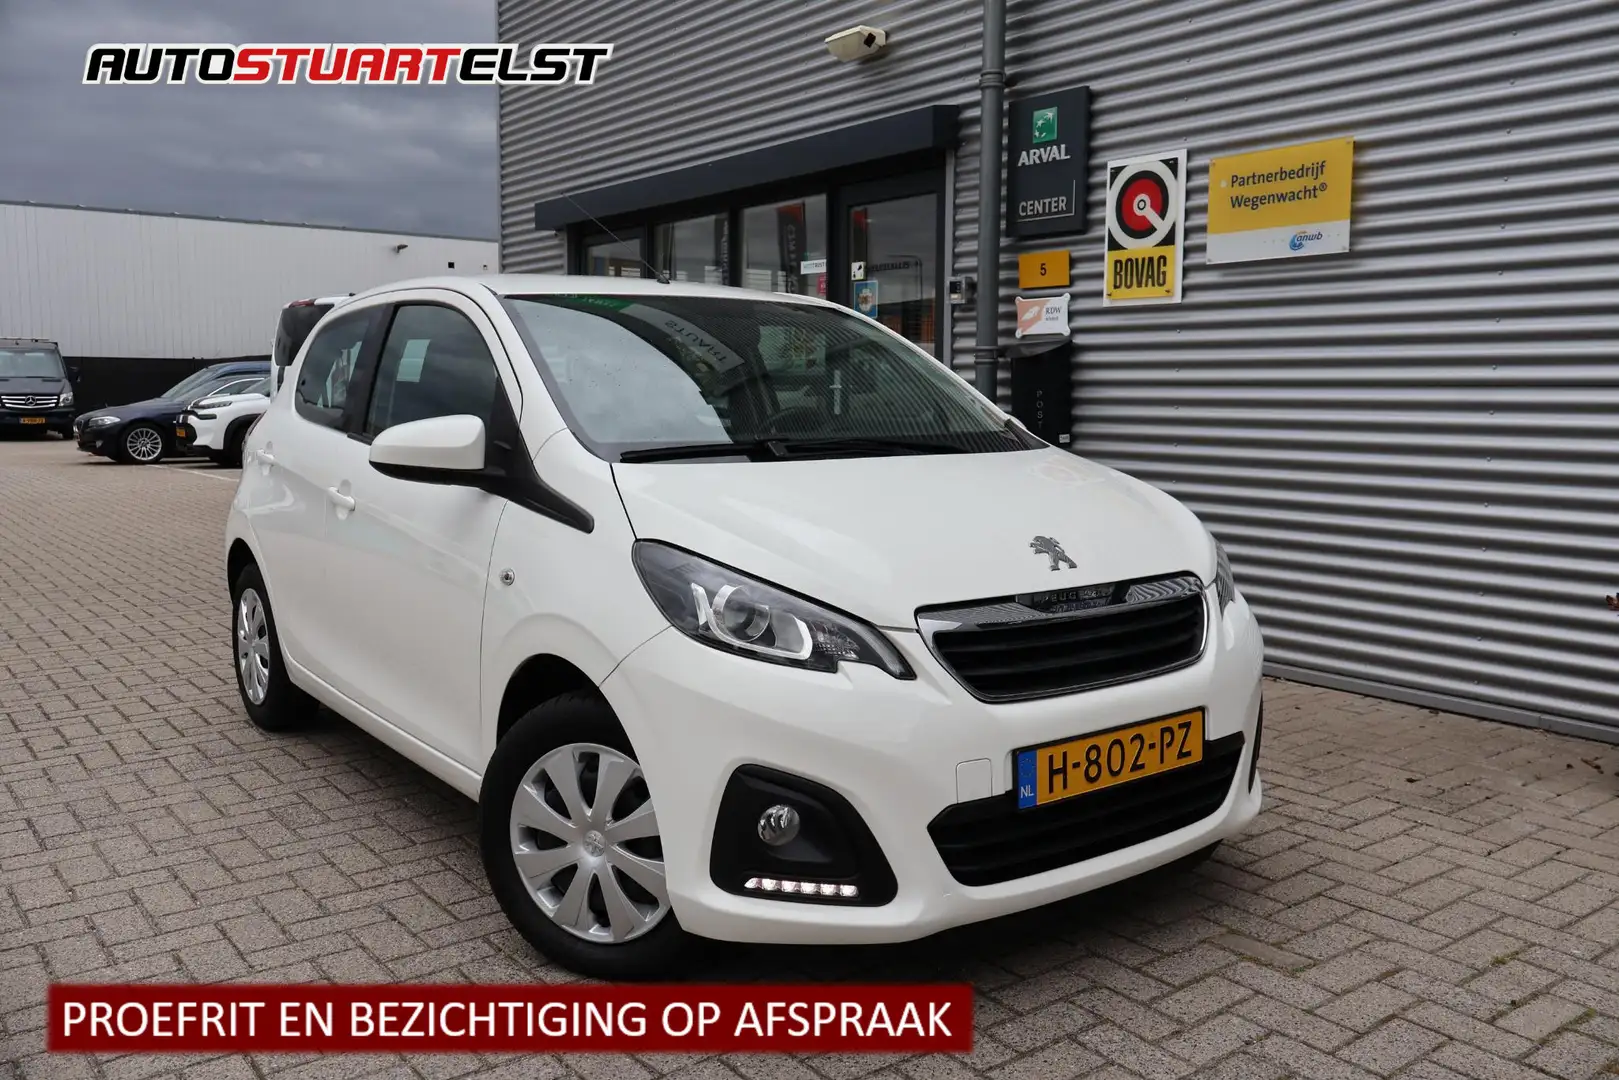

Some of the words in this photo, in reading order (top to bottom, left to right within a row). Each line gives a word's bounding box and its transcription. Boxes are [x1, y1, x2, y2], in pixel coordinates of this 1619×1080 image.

[1017, 144, 1071, 167] ARVAL
[1230, 160, 1327, 188] Partnerbedrijf
[1018, 196, 1067, 216] CENTER
[1295, 232, 1323, 242] anwb
[1039, 262, 1047, 276] 5
[1113, 254, 1168, 290] BOVAG
[1045, 305, 1063, 315] RDW
[1036, 390, 1044, 429] POST
[1048, 720, 1193, 794] H-802-PZ
[1020, 784, 1035, 799] NL
